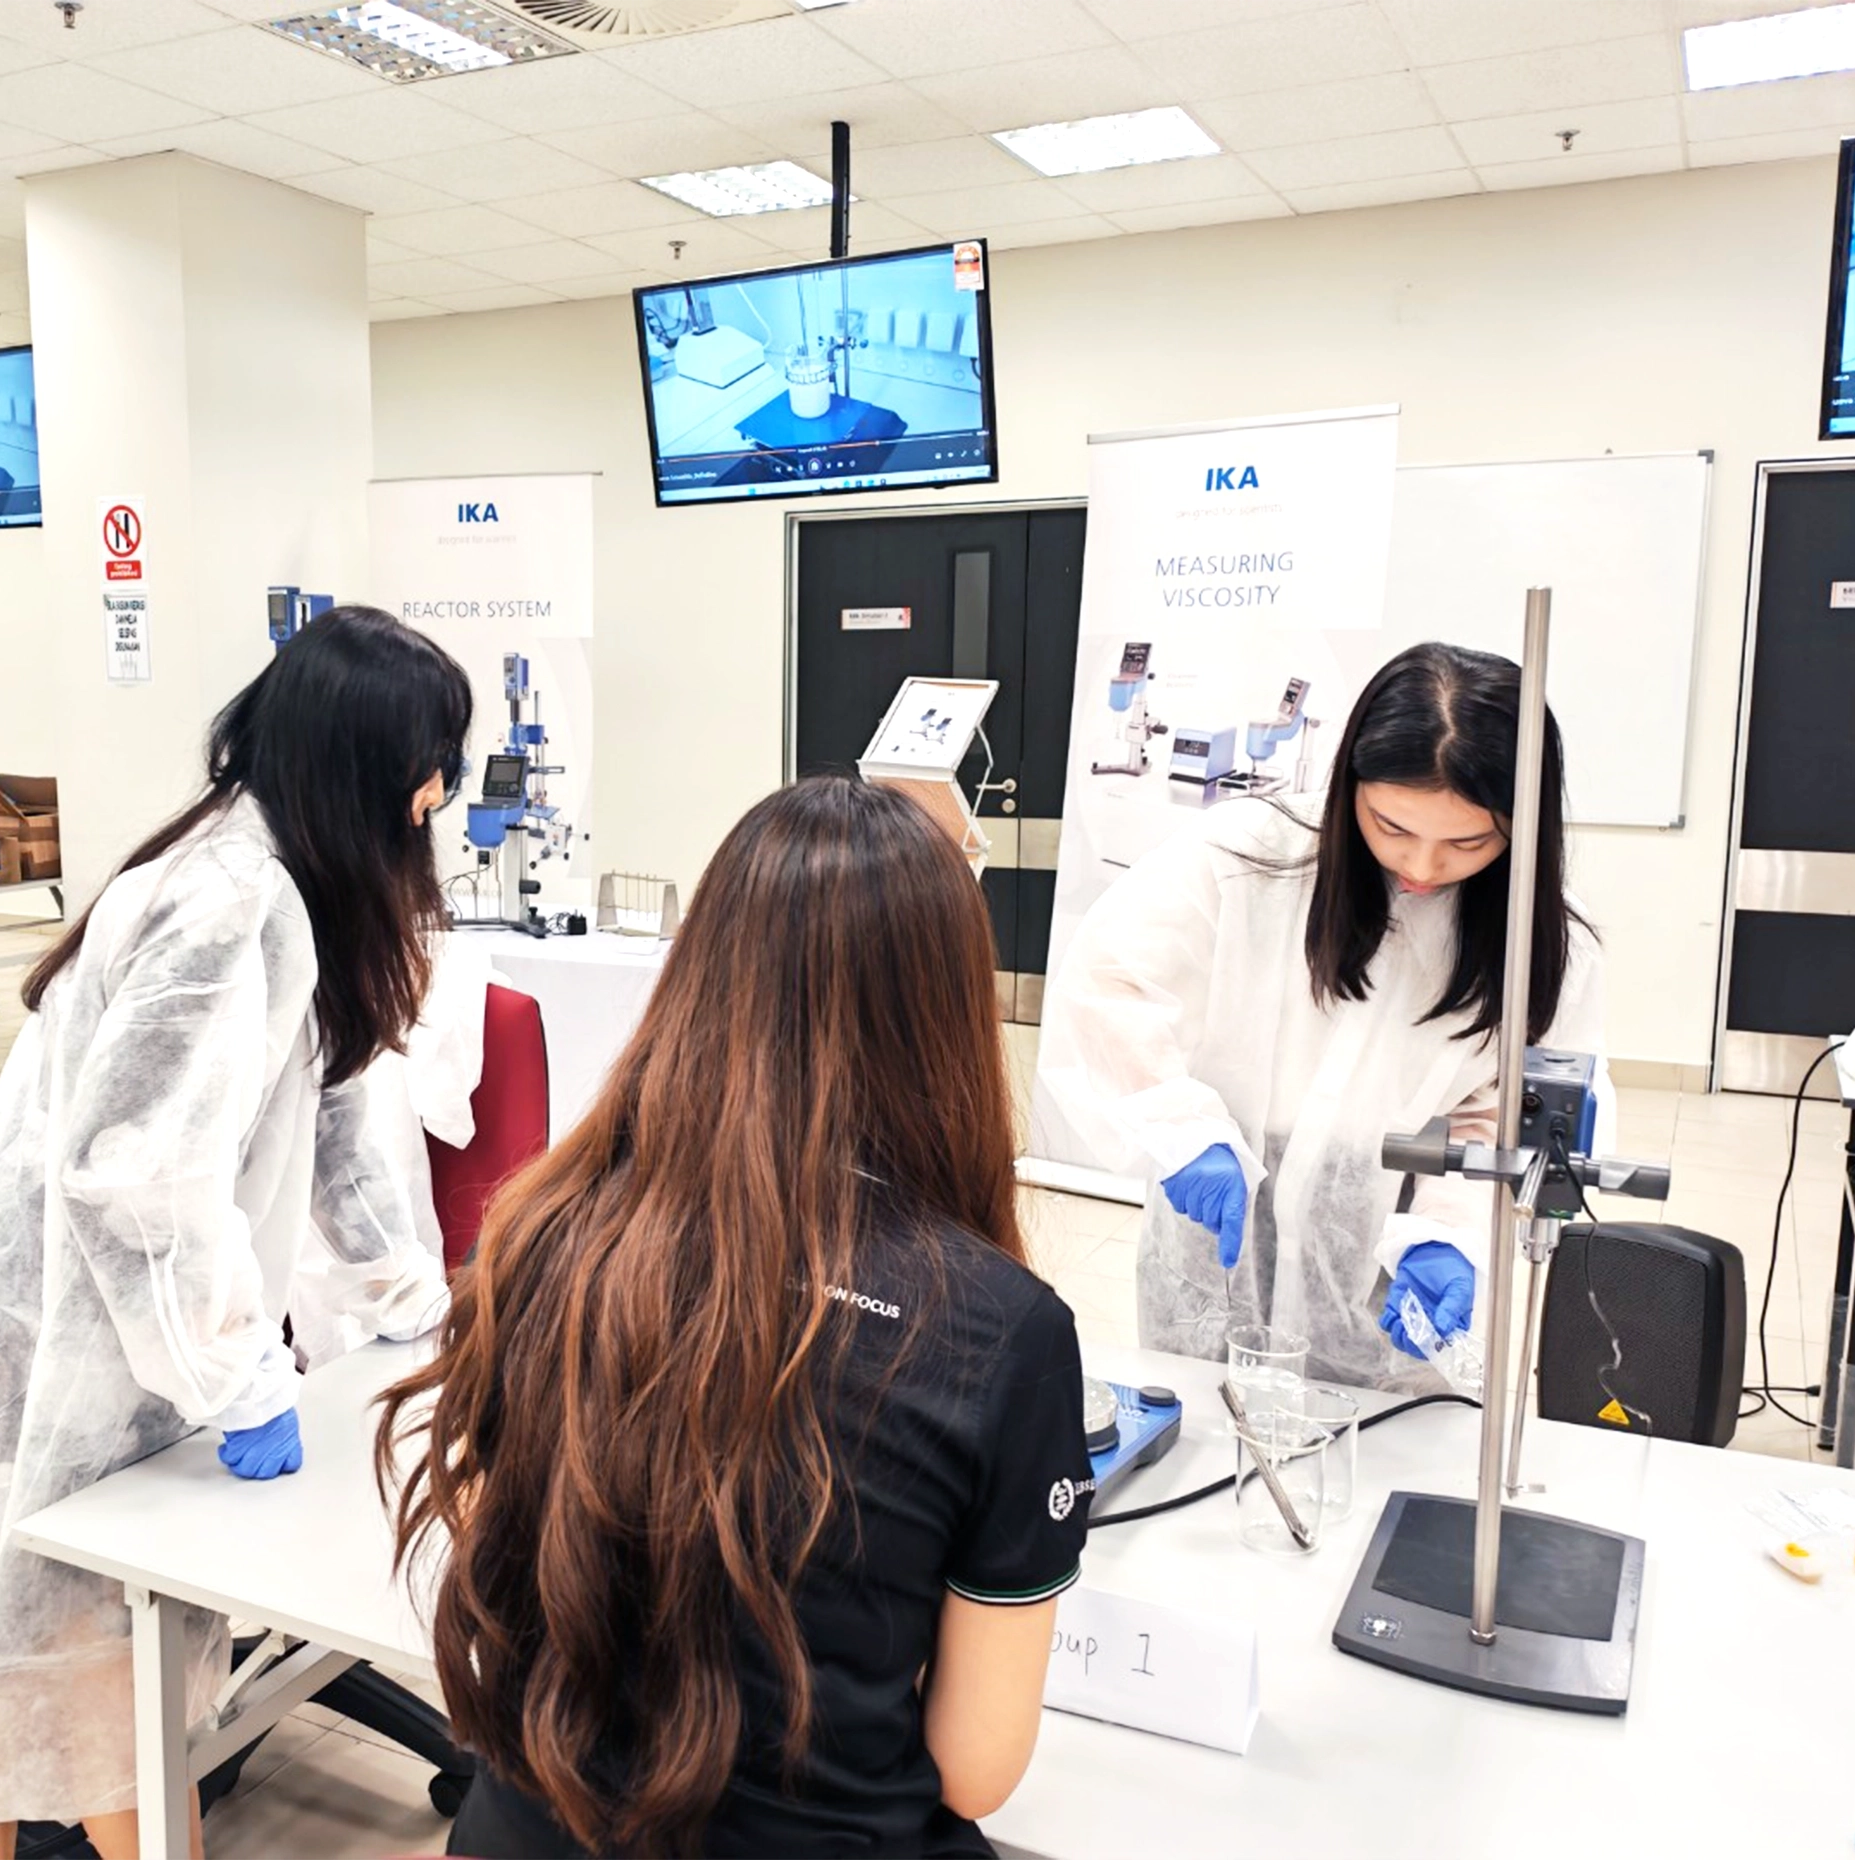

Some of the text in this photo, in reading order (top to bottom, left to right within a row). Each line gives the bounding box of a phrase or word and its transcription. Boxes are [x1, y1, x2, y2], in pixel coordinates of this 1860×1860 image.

[1205, 465, 1259, 492] IKA
[458, 502, 499, 523] IKA
[1155, 551, 1293, 577] MEASURING
[1163, 585, 1280, 607] VISCOSITY
[402, 600, 551, 619] REACTOR SYSTEM
[850, 1292, 901, 1319] FOCUS
[1131, 1633, 1154, 1676] 1
